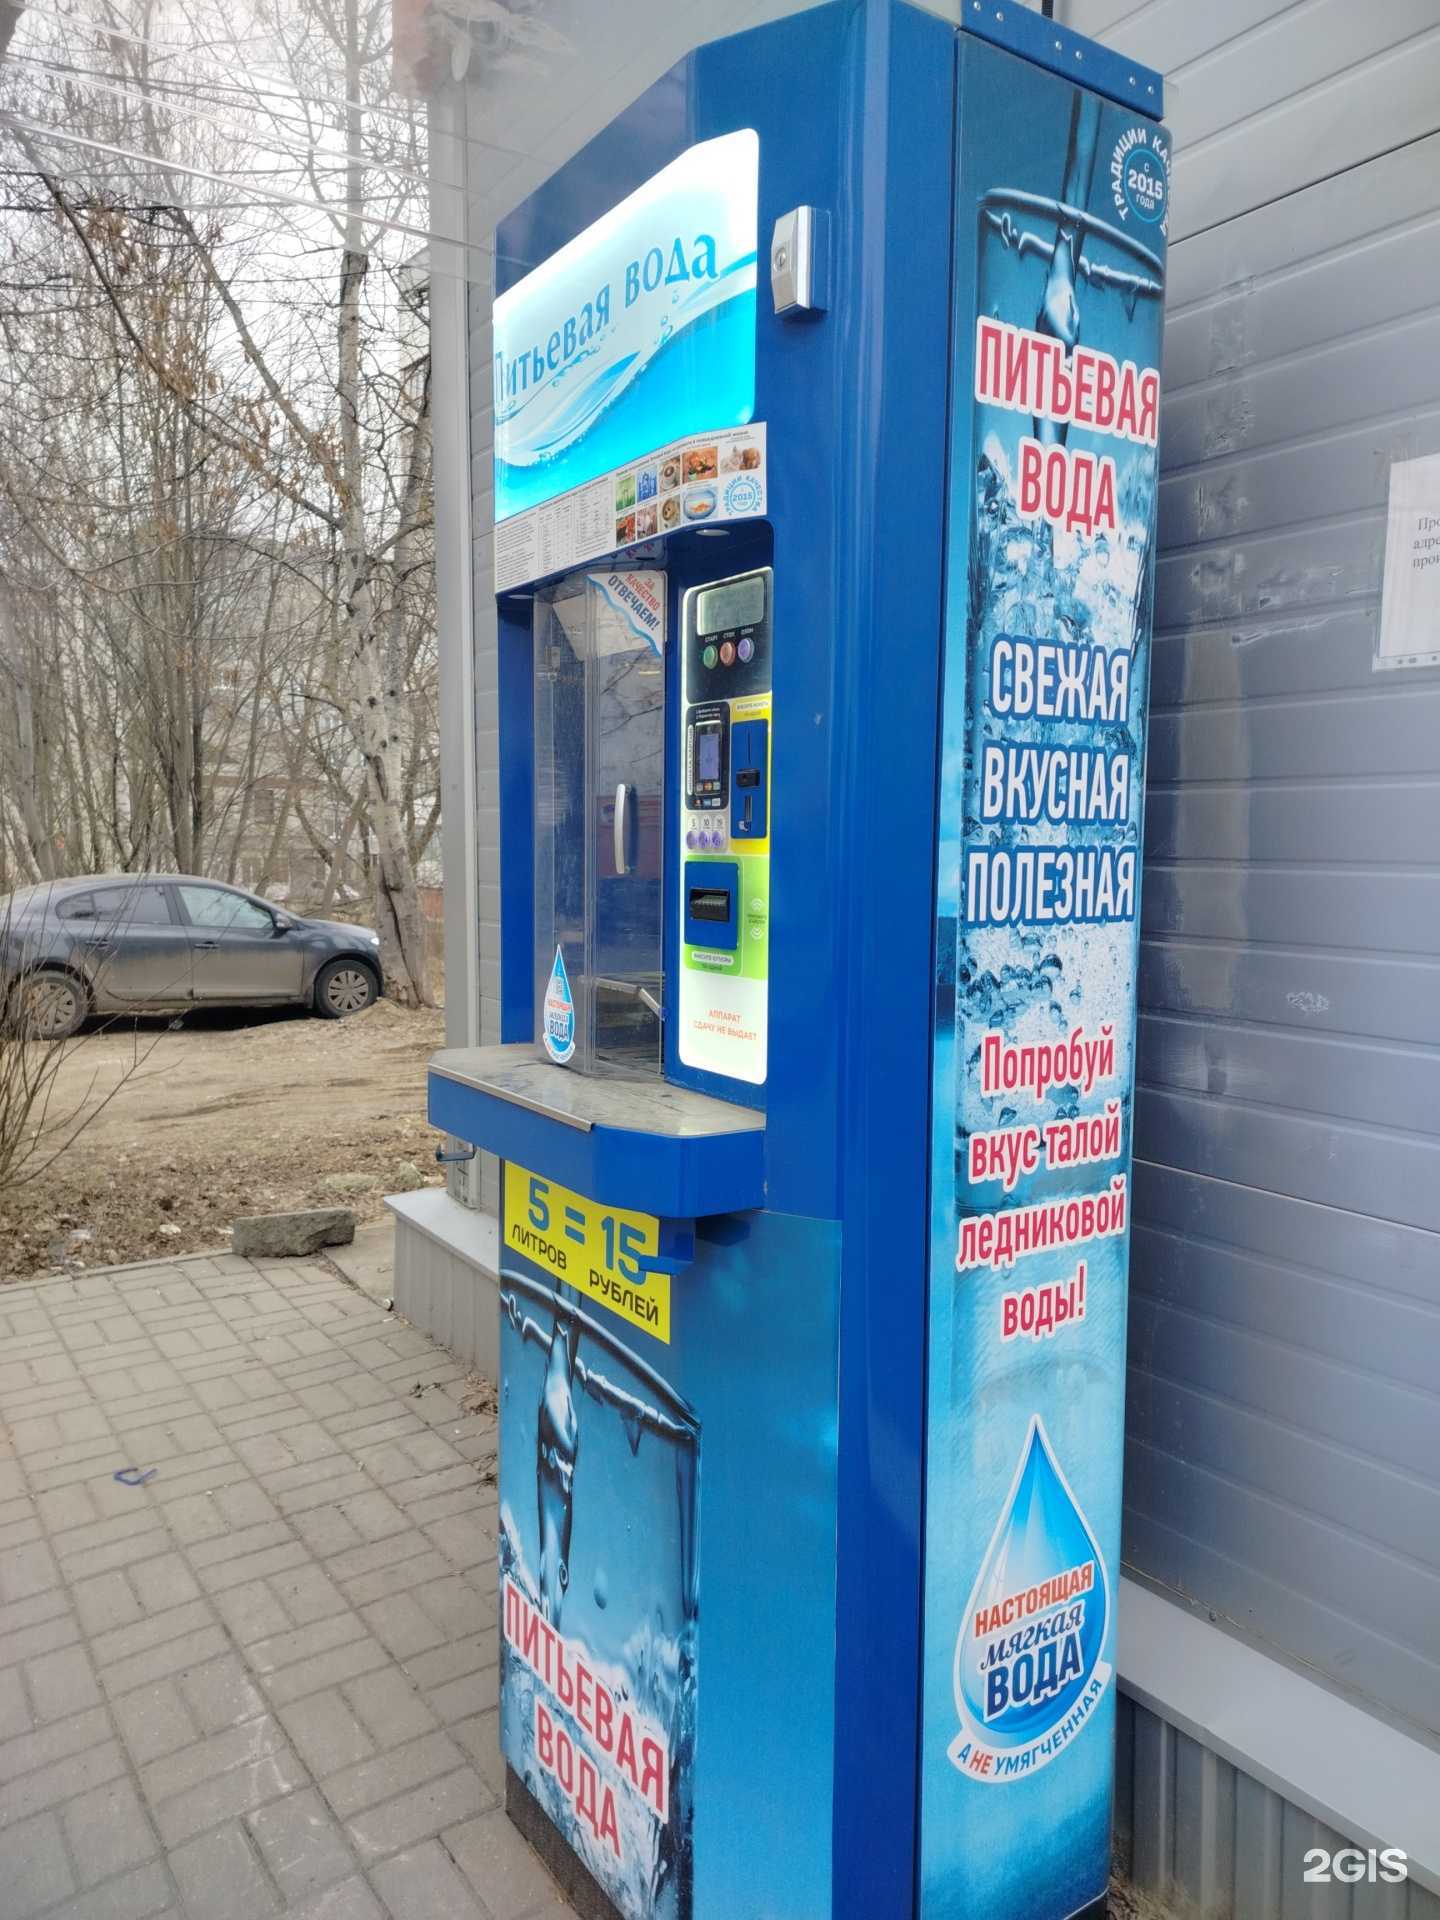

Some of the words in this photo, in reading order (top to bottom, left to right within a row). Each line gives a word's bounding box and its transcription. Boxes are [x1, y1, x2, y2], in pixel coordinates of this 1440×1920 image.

[1111, 128, 1147, 221] ТРАДИЦИИ
[1128, 169, 1163, 200] 2015
[496, 284, 610, 402] Питьевая
[977, 322, 1159, 443] ПИТЬЕВАЯ
[1019, 442, 1116, 537] ВОДА
[608, 574, 661, 631] ОТВЕЧАЕМ!
[625, 573, 661, 612] КАЧЕСТВО
[992, 639, 1130, 722] СВЕЖАЯ
[983, 746, 1129, 820] ВКУСНАЯ
[967, 851, 1136, 923] ПОЛЕЗНАЯ
[549, 1020, 568, 1039] ВОДА
[708, 1009, 742, 1024] АППАРАТ
[716, 1024, 727, 1034] НЕ
[983, 1024, 1114, 1098] Попробуй
[971, 1127, 1038, 1186] вкус
[1045, 1103, 1120, 1164] талой
[528, 1176, 551, 1232] 5
[601, 1215, 647, 1286] 15
[959, 1178, 1125, 1265] ледниковой
[511, 1223, 567, 1270] ЛИТРОВ
[589, 1269, 659, 1326] РУБЛЕЙ
[1003, 1265, 1084, 1336] воды!
[975, 1563, 1093, 1638] НАСТОЯЩАЯ
[980, 1604, 1083, 1671] мягкая
[506, 1580, 665, 1814] ПИТЬЕВАЯ
[987, 1632, 1082, 1717] ВОДА
[957, 1743, 969, 1765] А
[969, 1749, 993, 1775] НЕ
[994, 1680, 1103, 1776] УМЯГЧЕННАЯ
[537, 1702, 622, 1857] ВОДА
